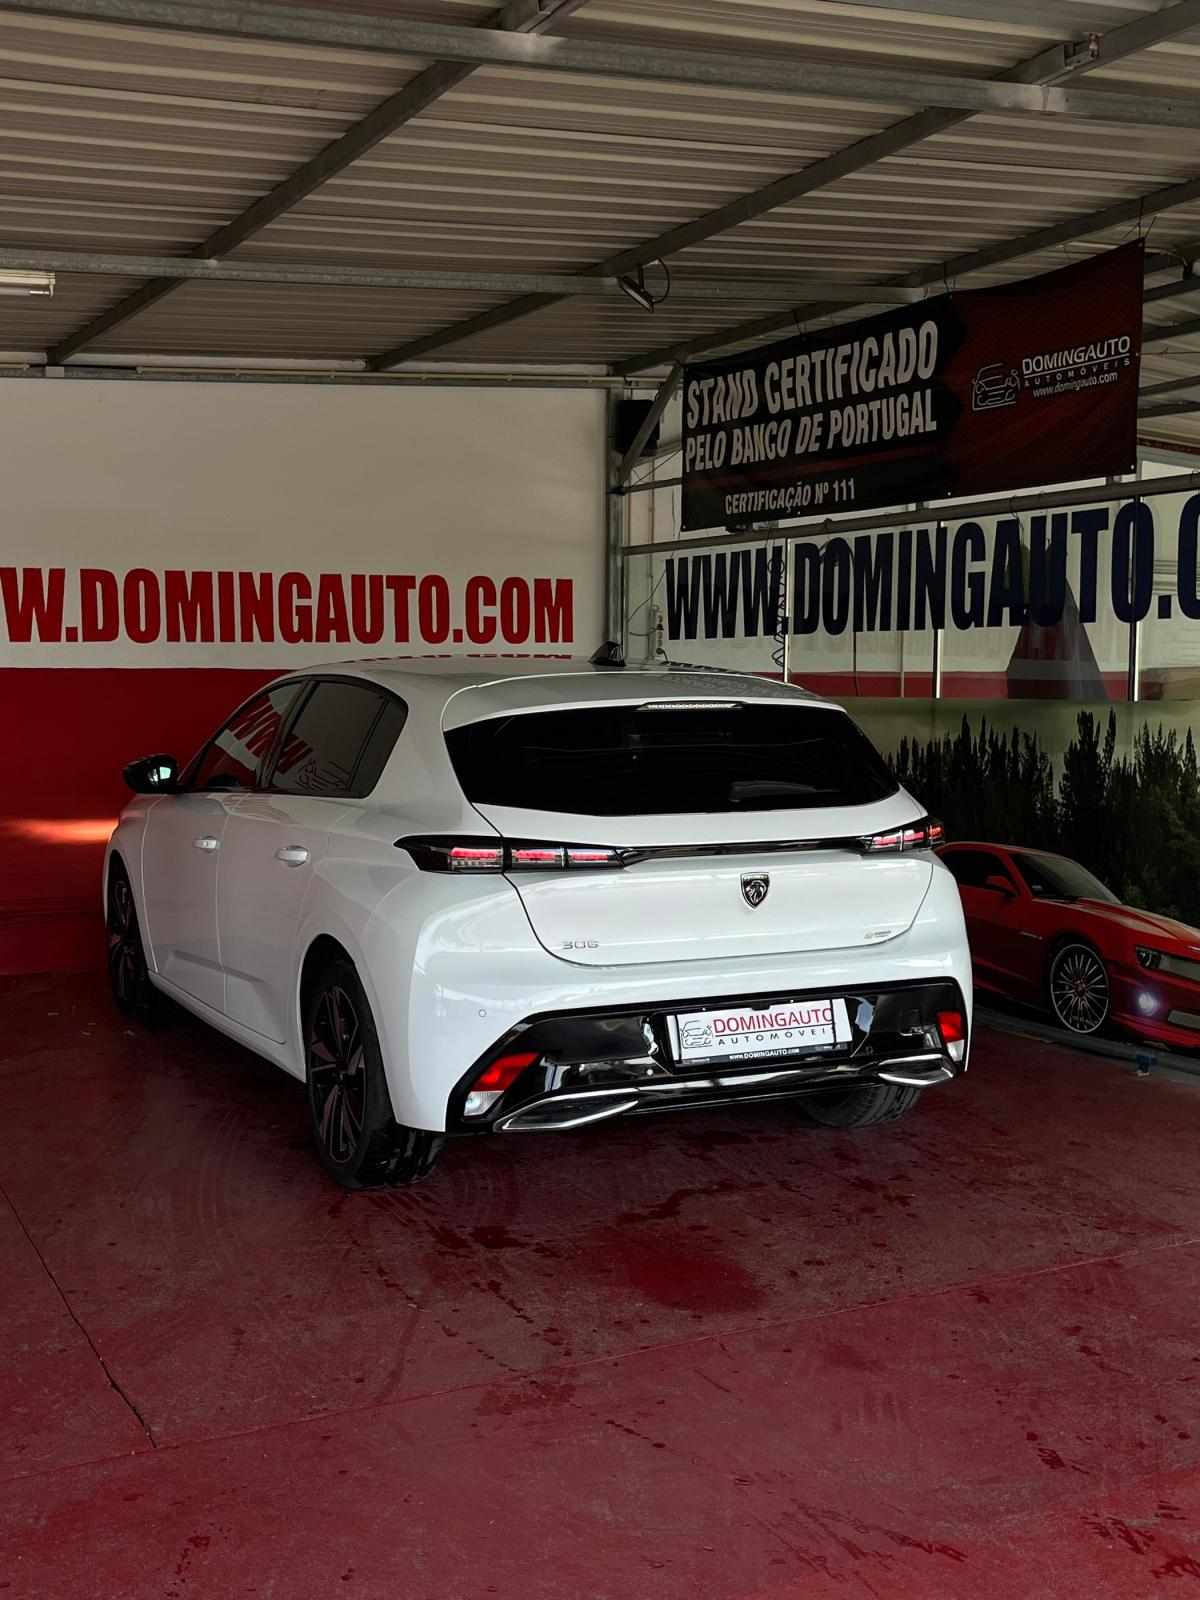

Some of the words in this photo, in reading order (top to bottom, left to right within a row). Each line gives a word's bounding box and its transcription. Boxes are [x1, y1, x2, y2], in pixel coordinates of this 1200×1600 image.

[687, 369, 759, 429] STAND
[764, 320, 938, 414] CERTIFICADO
[1022, 336, 1131, 375] DOMINGAUTO
[685, 431, 727, 472] PELO
[730, 419, 791, 465] BANCO
[795, 412, 823, 455] DE
[826, 388, 937, 449] PORTUGAL
[725, 481, 811, 515] CERTIFICAÇÃO
[832, 478, 855, 502] 111
[0, 567, 574, 644] W.DOMINGAUTO.COM
[717, 1026, 834, 1046] AUTOMOVEI
